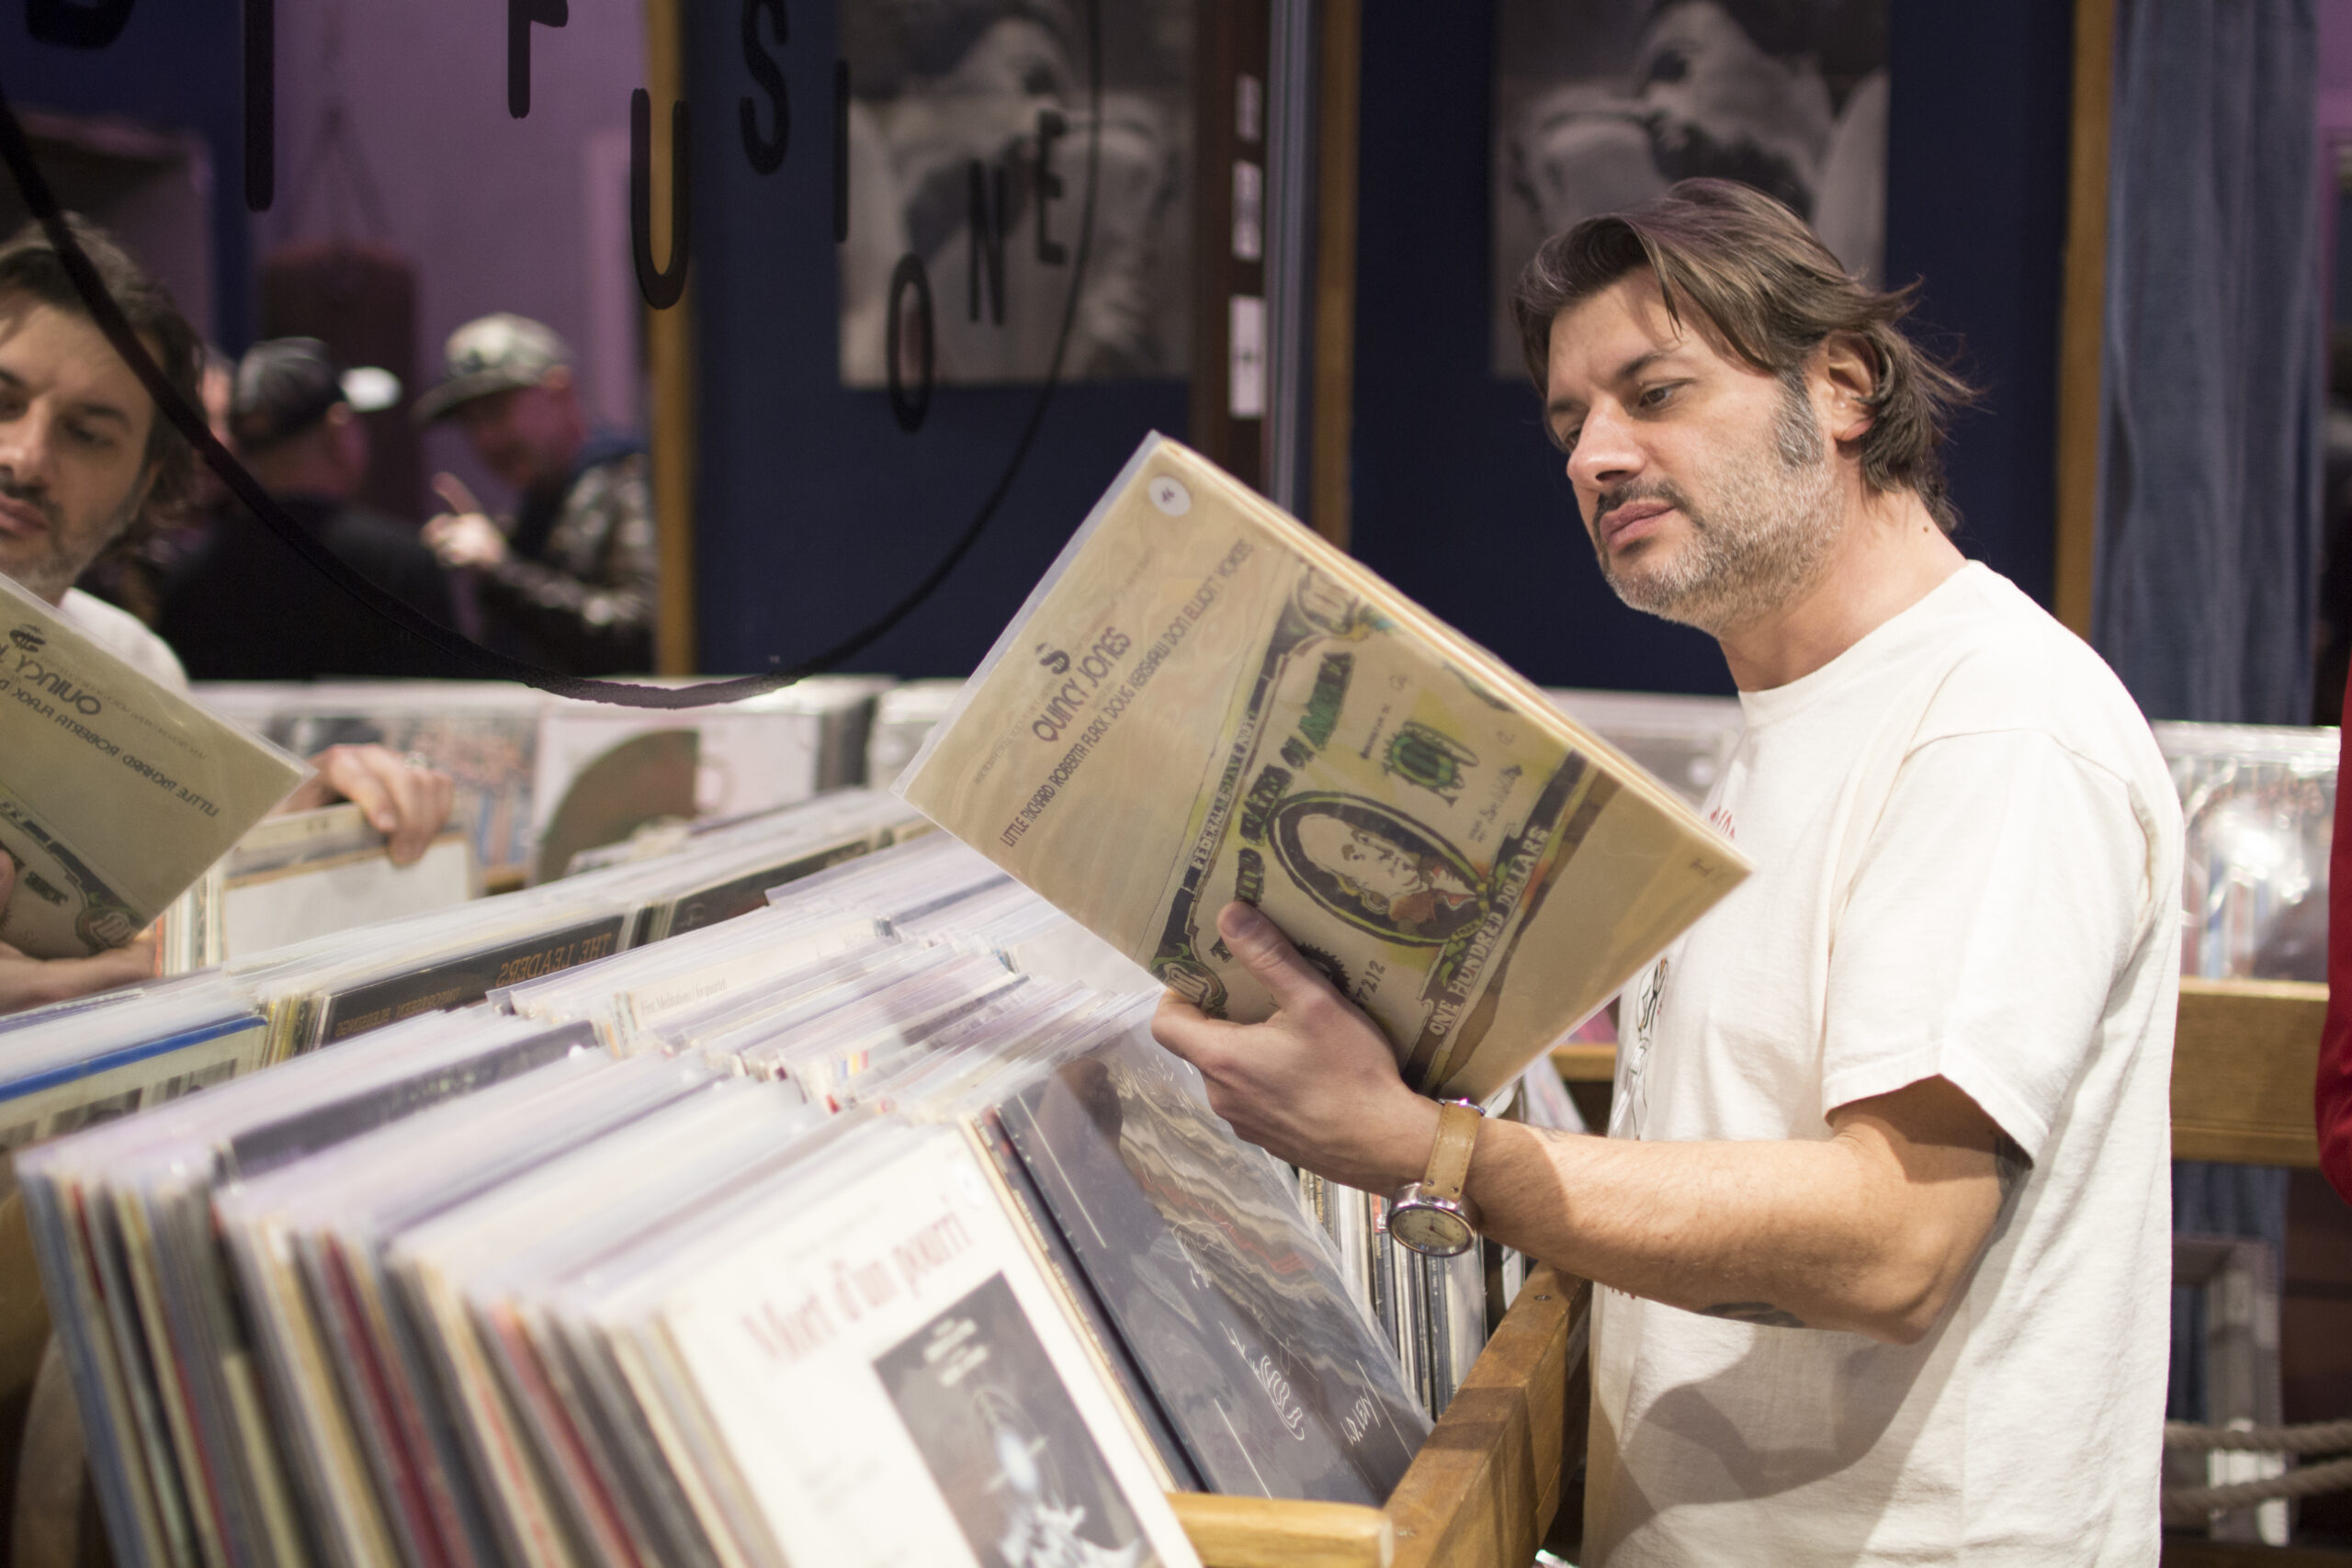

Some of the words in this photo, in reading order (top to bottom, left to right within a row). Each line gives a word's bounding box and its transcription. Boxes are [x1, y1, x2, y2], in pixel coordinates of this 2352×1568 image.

[1001, 818, 1028, 848] LITTLE
[1022, 784, 1056, 822] RICHARD
[1051, 742, 1088, 787] ROBERTA
[1082, 716, 1109, 748] FLACK
[1106, 685, 1136, 718] DOUG
[1128, 641, 1170, 690] KERSHAW
[1163, 615, 1191, 645] DON
[1184, 578, 1223, 619] ELLIOTT
[1032, 682, 1089, 743] QUINCY
[1077, 626, 1131, 686] JONES
[1193, 809, 1225, 869] FEDERAL
[1428, 999, 1459, 1037] ONE
[1449, 911, 1507, 998] HUNDRED
[1497, 827, 1550, 908] DOLLARS
